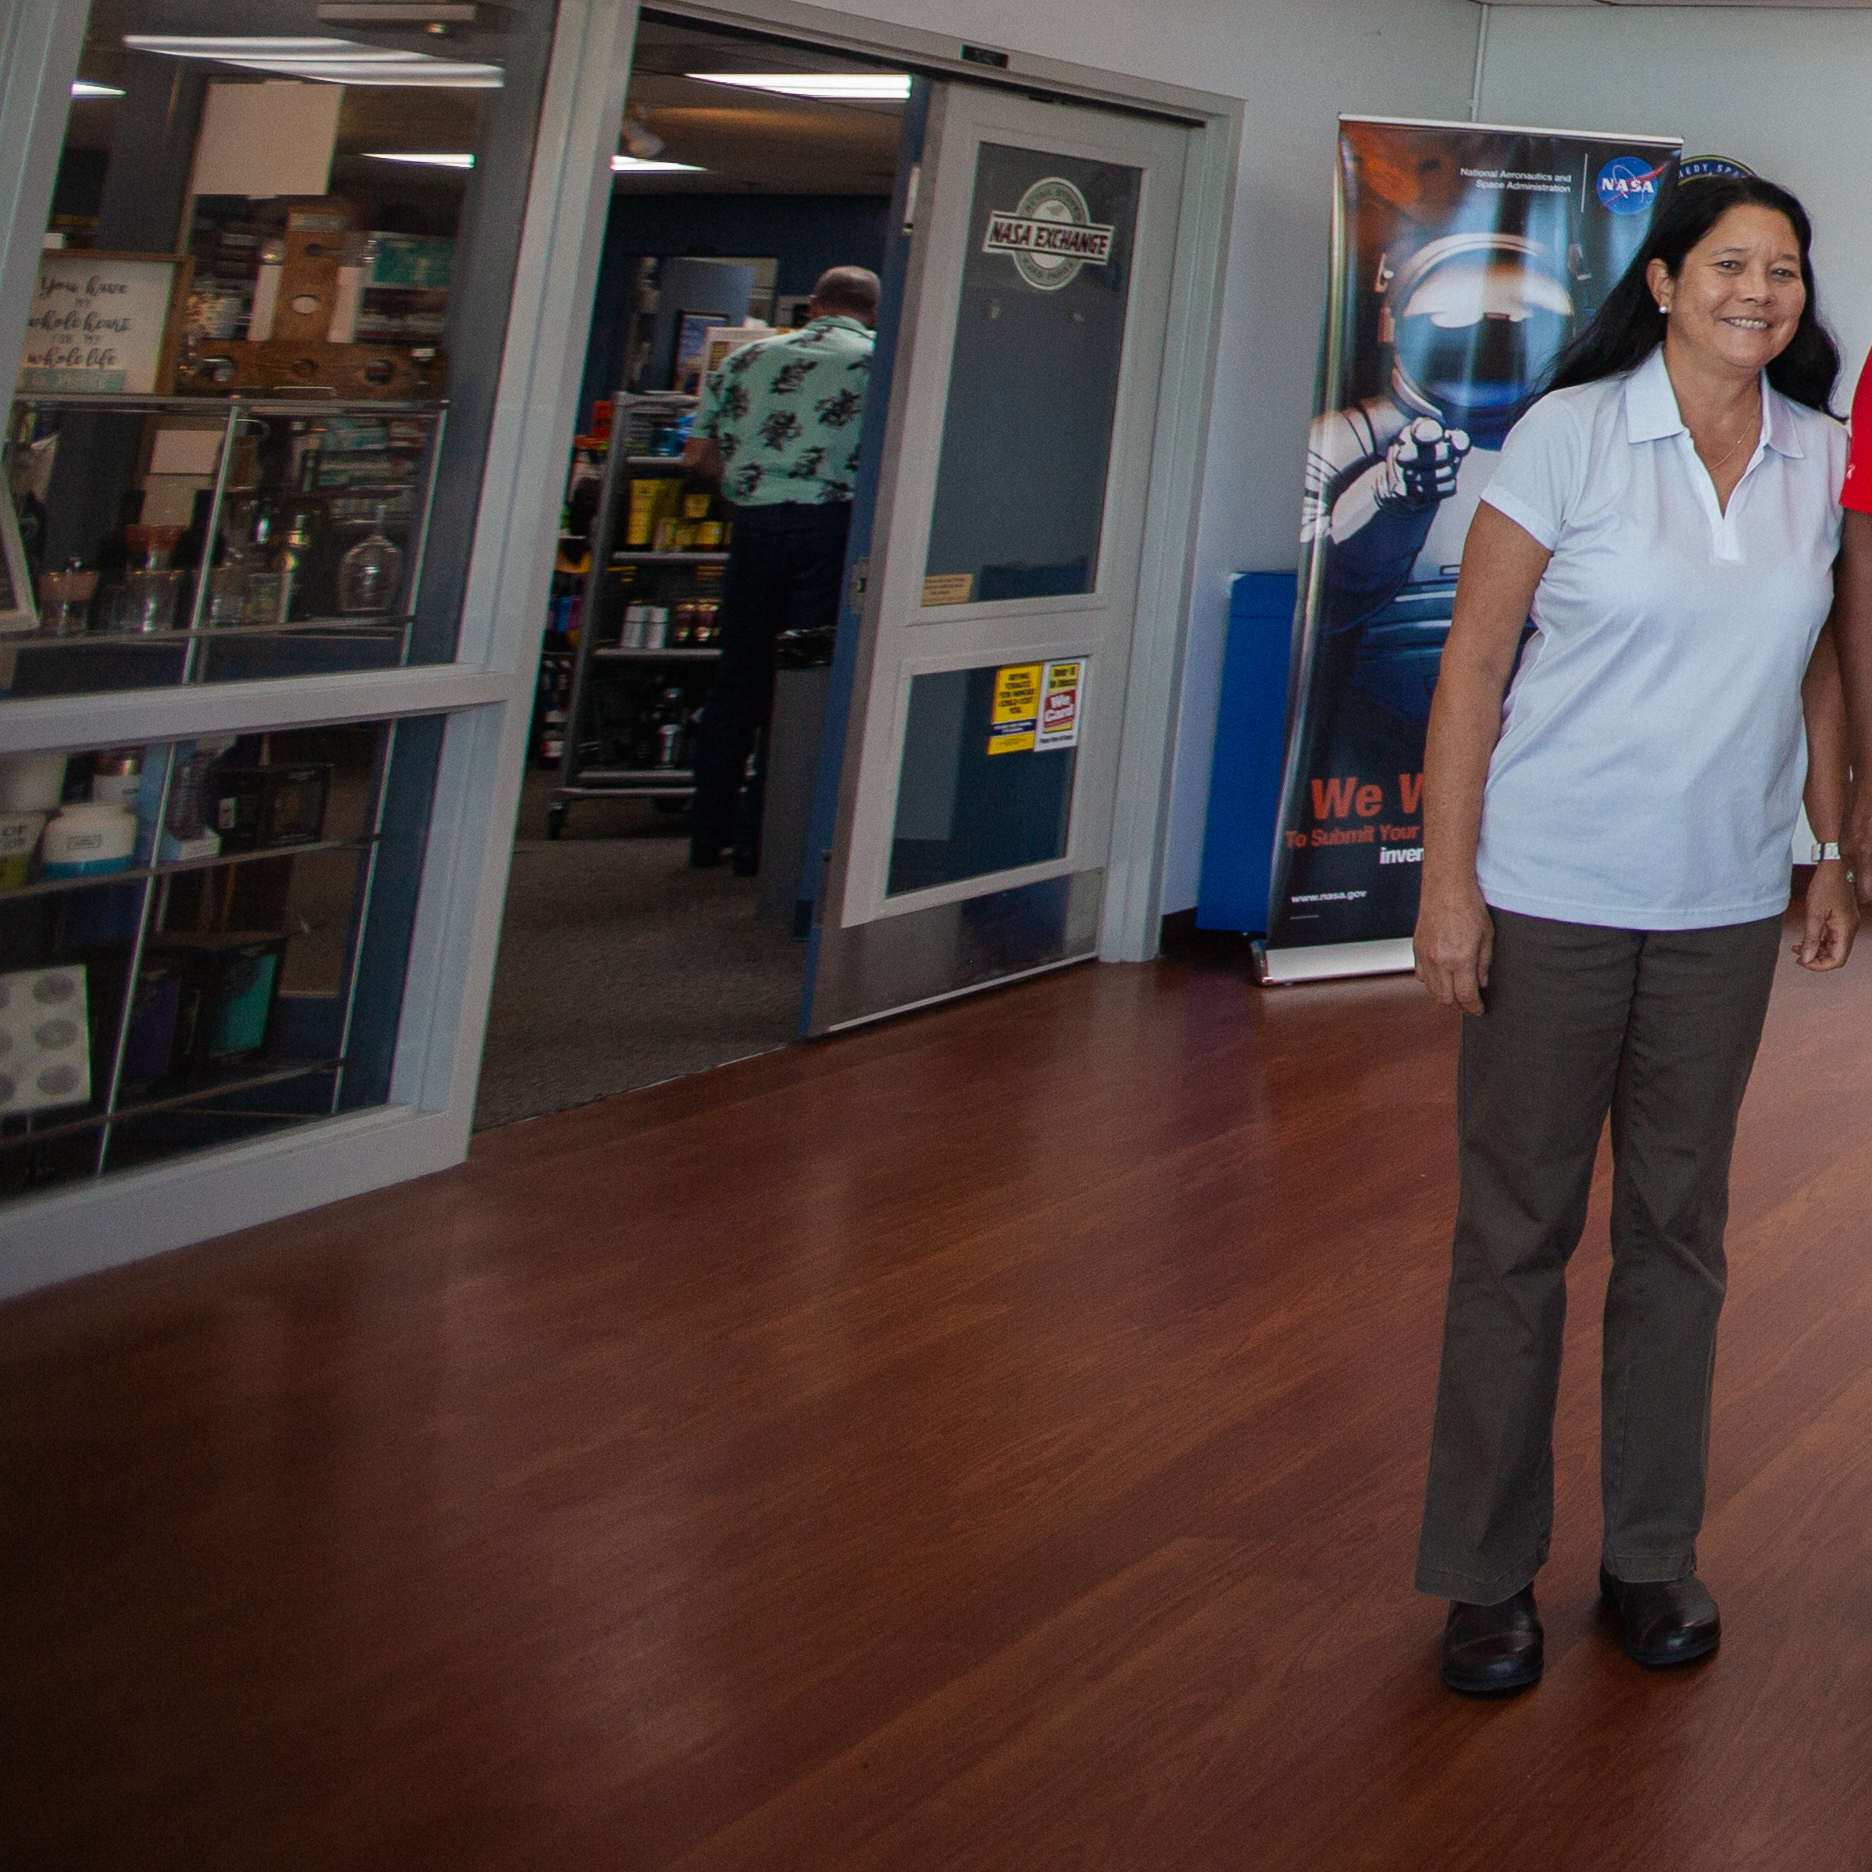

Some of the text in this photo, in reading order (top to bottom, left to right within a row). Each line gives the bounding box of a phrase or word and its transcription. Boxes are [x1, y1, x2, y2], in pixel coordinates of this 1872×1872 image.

[1460, 167, 1572, 183] National Aeronautics and
[1475, 179, 1571, 193] Space Administration
[1602, 177, 1654, 194] NASA
[989, 220, 1109, 256] NASA EXCHANGE
[1311, 777, 1383, 820] We
[1285, 825, 1420, 849] To Submit Your
[1290, 890, 1367, 904] www.nasa.gov
